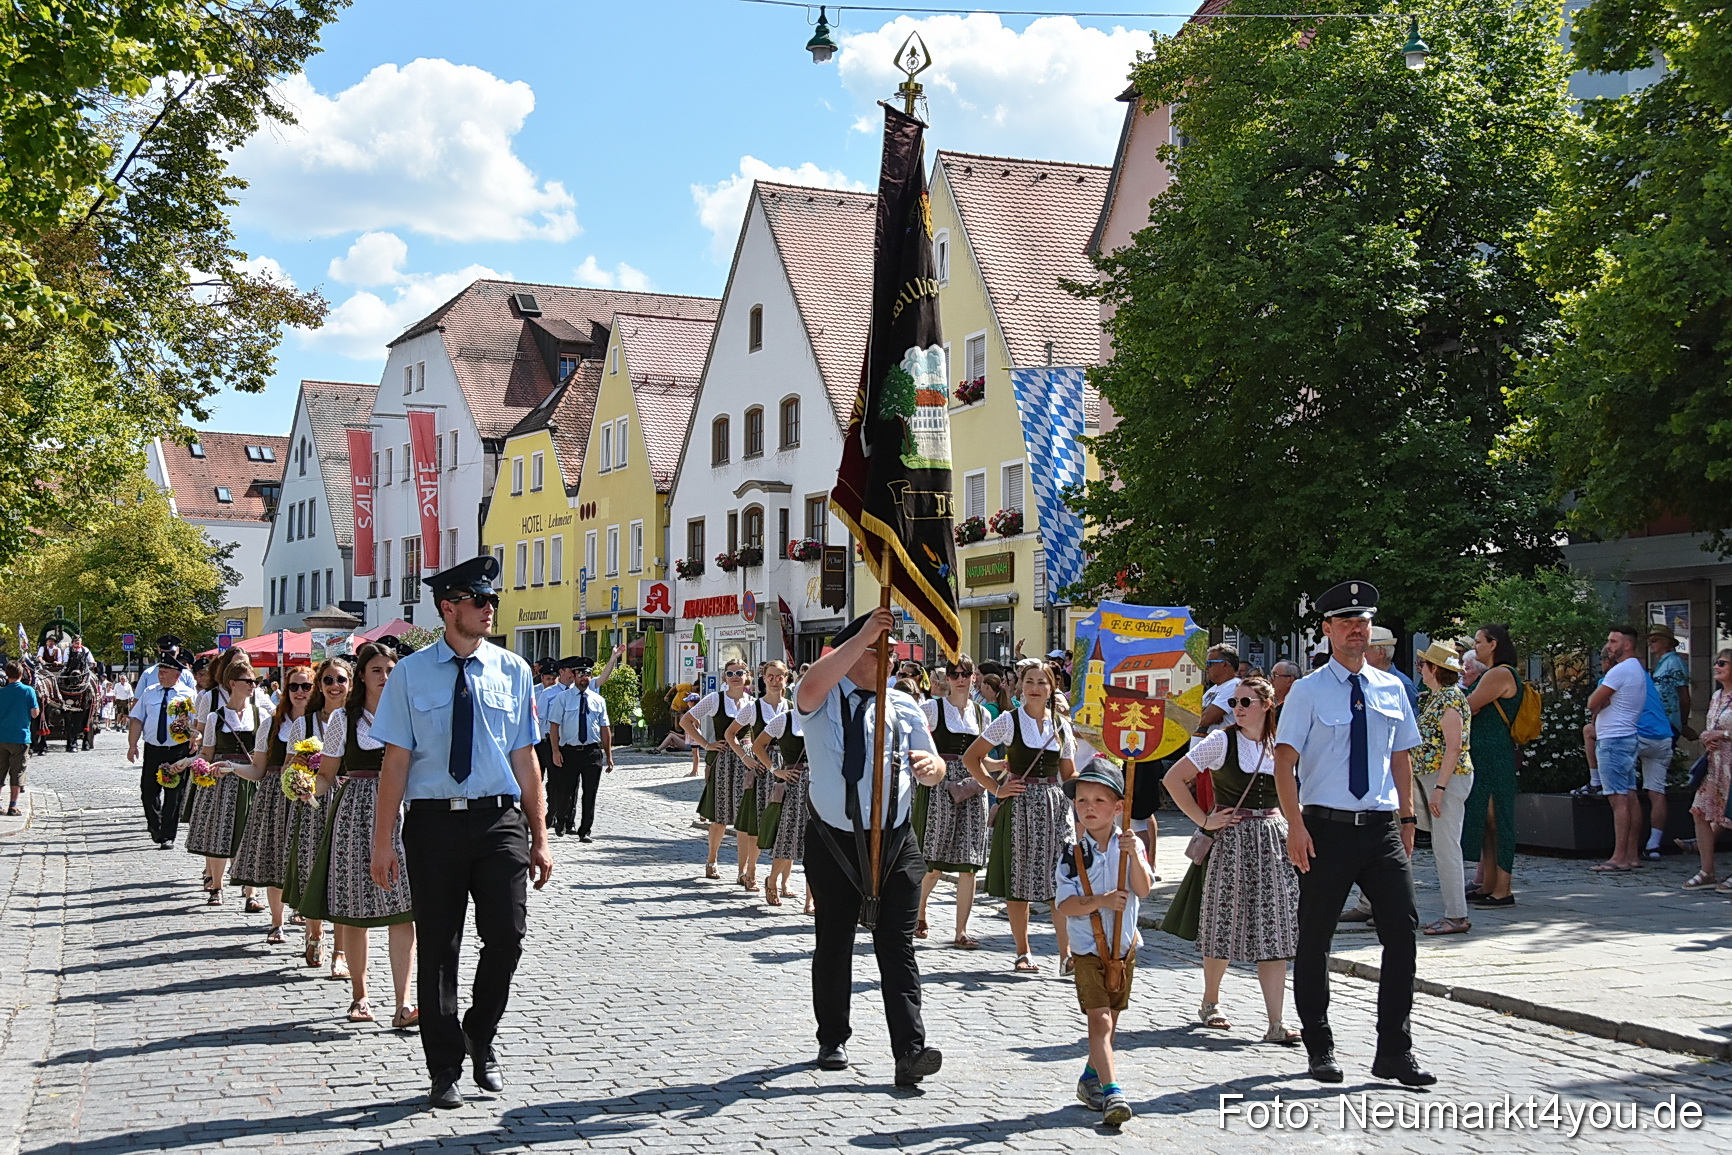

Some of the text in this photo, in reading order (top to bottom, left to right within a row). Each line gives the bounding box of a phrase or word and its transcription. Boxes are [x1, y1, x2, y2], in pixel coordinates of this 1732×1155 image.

[355, 476, 373, 529] SALE
[521, 513, 543, 535] HOTEL
[580, 571, 586, 590] P
[612, 590, 618, 609] P
[682, 594, 739, 619] APOTHEKE
[518, 608, 549, 622] Restaurant
[1135, 621, 1174, 637] Pölling
[709, 678, 715, 687] P
